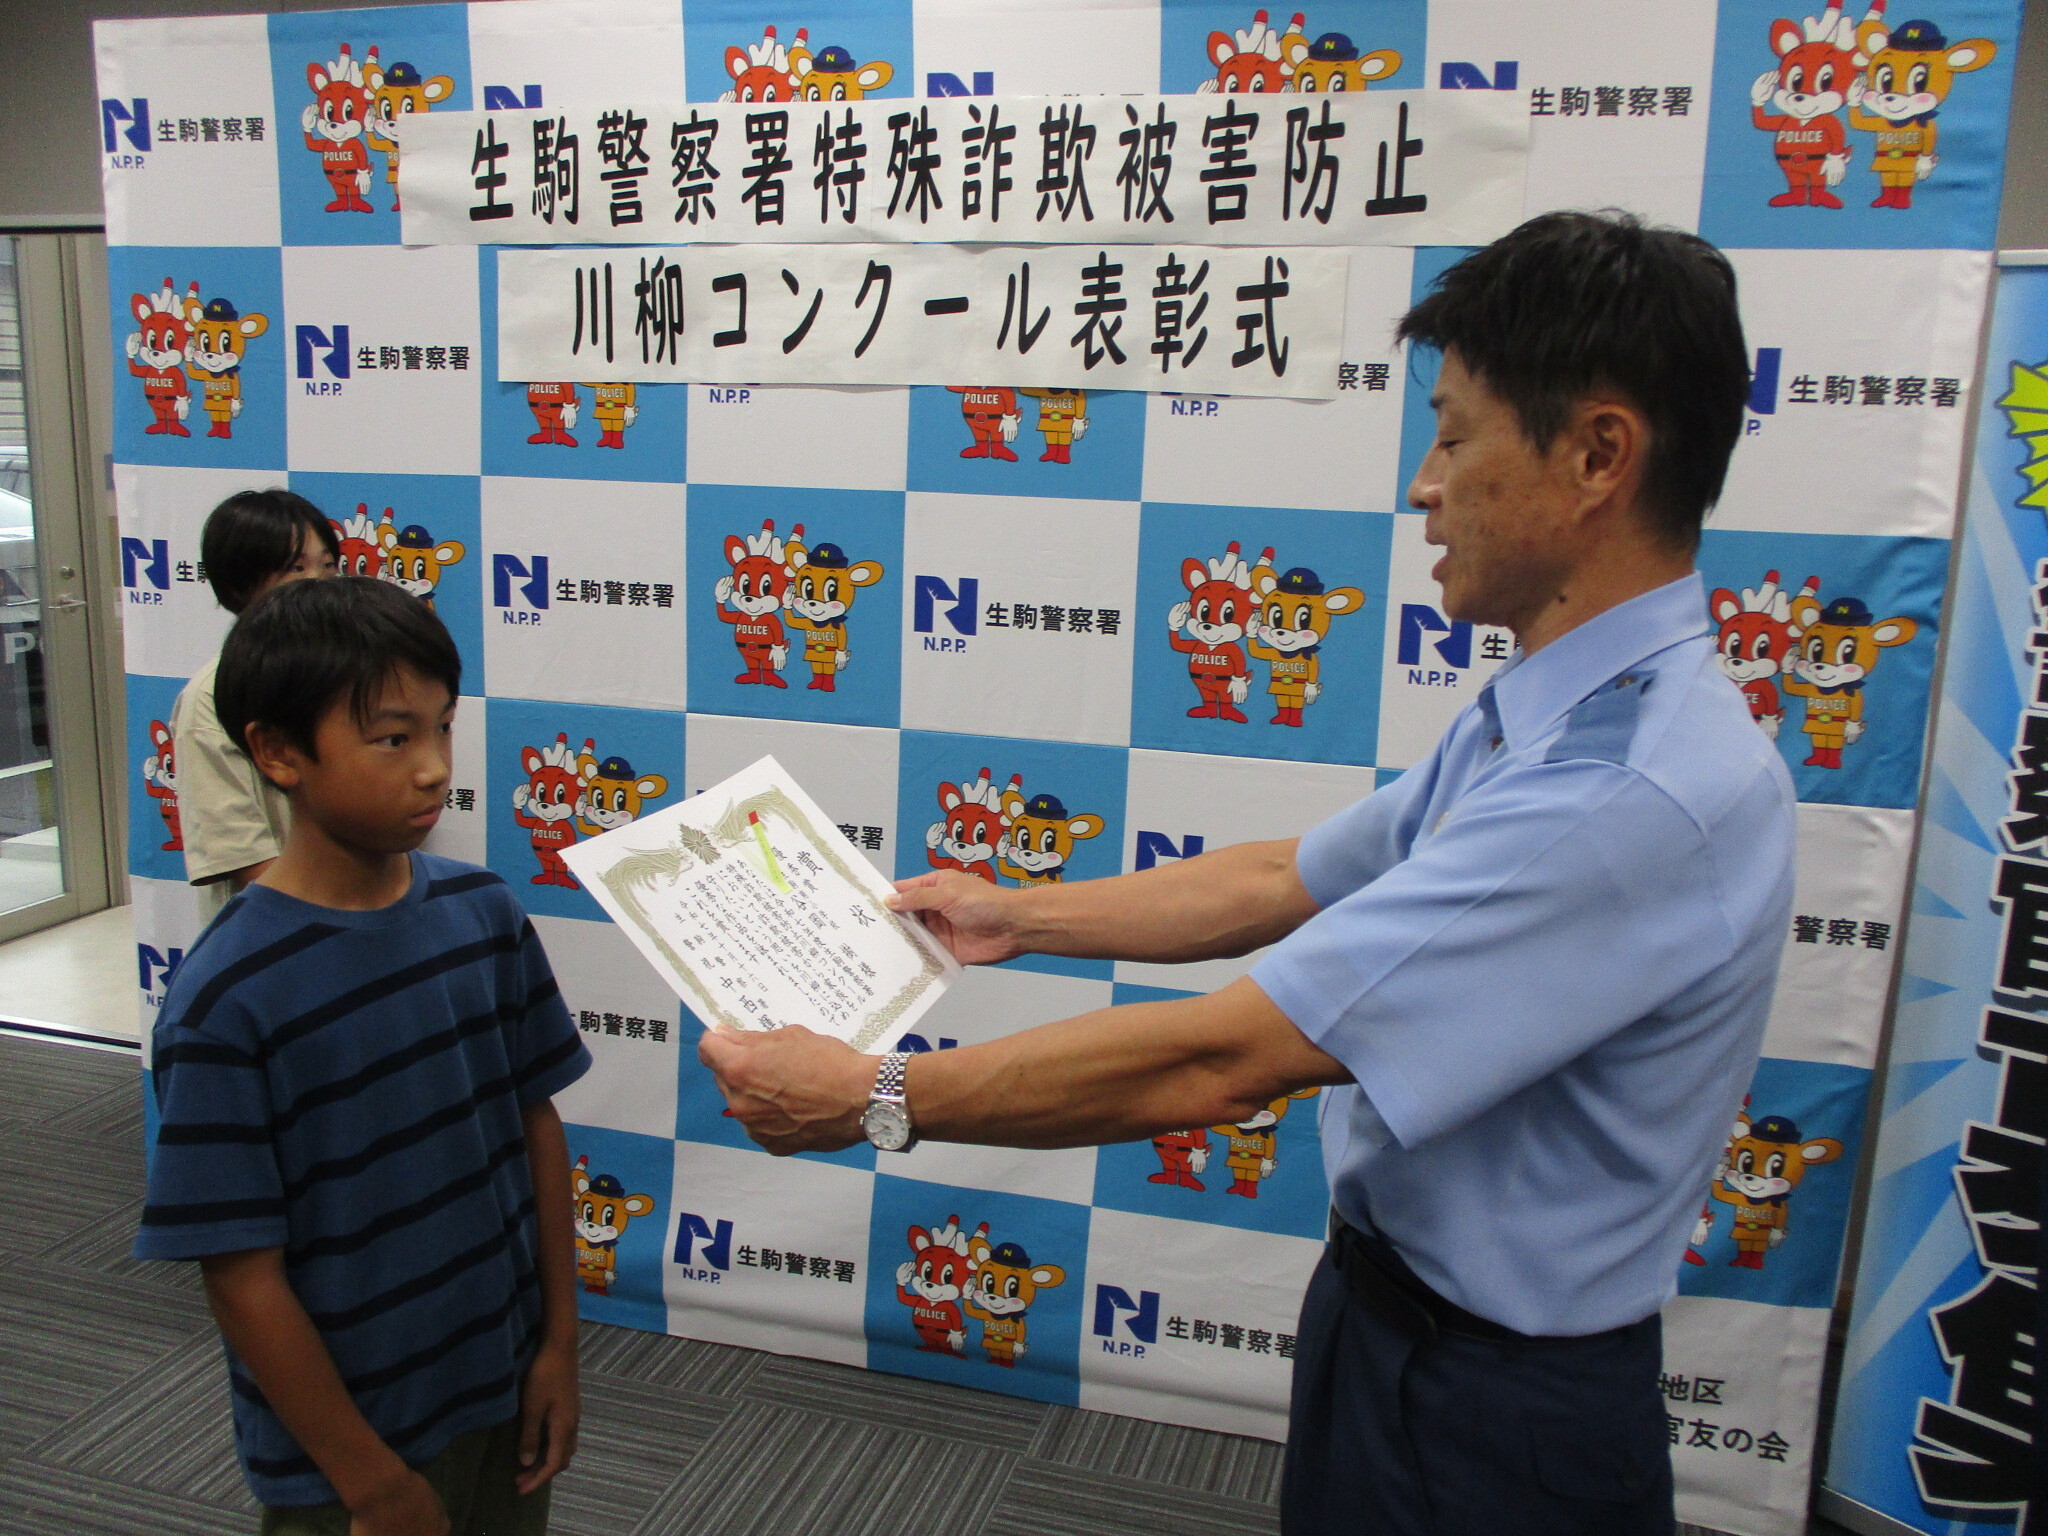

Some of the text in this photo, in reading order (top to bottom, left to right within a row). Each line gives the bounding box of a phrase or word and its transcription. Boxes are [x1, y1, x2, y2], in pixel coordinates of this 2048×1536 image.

[1531, 86, 1694, 117] 生駒警察署
[157, 117, 266, 143] 生駒警察署
[1776, 130, 1823, 143] POLICE
[111, 156, 145, 168] N.P.P.
[323, 150, 353, 161] POLICE
[469, 99, 1427, 227] 生駒警察署特殊詐欺被害防止
[573, 252, 1289, 377] 川柳コンクール表彰式
[357, 346, 470, 371] 生駒警察署
[146, 378, 174, 388] POLICE
[305, 382, 343, 396] N.P.P.
[529, 384, 560, 394] POLICE
[597, 388, 624, 399] POLICE
[710, 390, 750, 404] N.P.P.
[964, 393, 999, 404] POLICE
[1788, 375, 1962, 408] 生駒警察署
[1041, 398, 1073, 409] POLICE
[1171, 400, 1218, 417] N.P.P.
[130, 591, 163, 606] N.P.P.
[556, 578, 675, 609] 生駒警察署
[503, 612, 541, 626] N.P.P.
[985, 601, 1122, 637] 生駒警察署
[736, 624, 768, 636] POLICE
[806, 630, 835, 642] POLICE
[923, 636, 967, 654] N.P.P.
[1191, 652, 1228, 665] POLICE
[1272, 659, 1306, 673] POLICE
[1408, 669, 1458, 688] N.P.P.
[1807, 697, 1847, 710] POLICE
[532, 828, 562, 840] POLICE
[797, 851, 876, 928] 賞 状
[1794, 914, 1891, 951] 警察署
[570, 1011, 668, 1042] 駒警察署
[1231, 1137, 1262, 1149] POLICE
[579, 1250, 605, 1261] POLICE
[737, 1245, 855, 1283] 生駒警察署
[683, 1267, 720, 1284] N.P.P.
[914, 1307, 946, 1319] POLICE
[985, 1321, 1014, 1333] POLICE
[1103, 1340, 1145, 1357] N.P.P.
